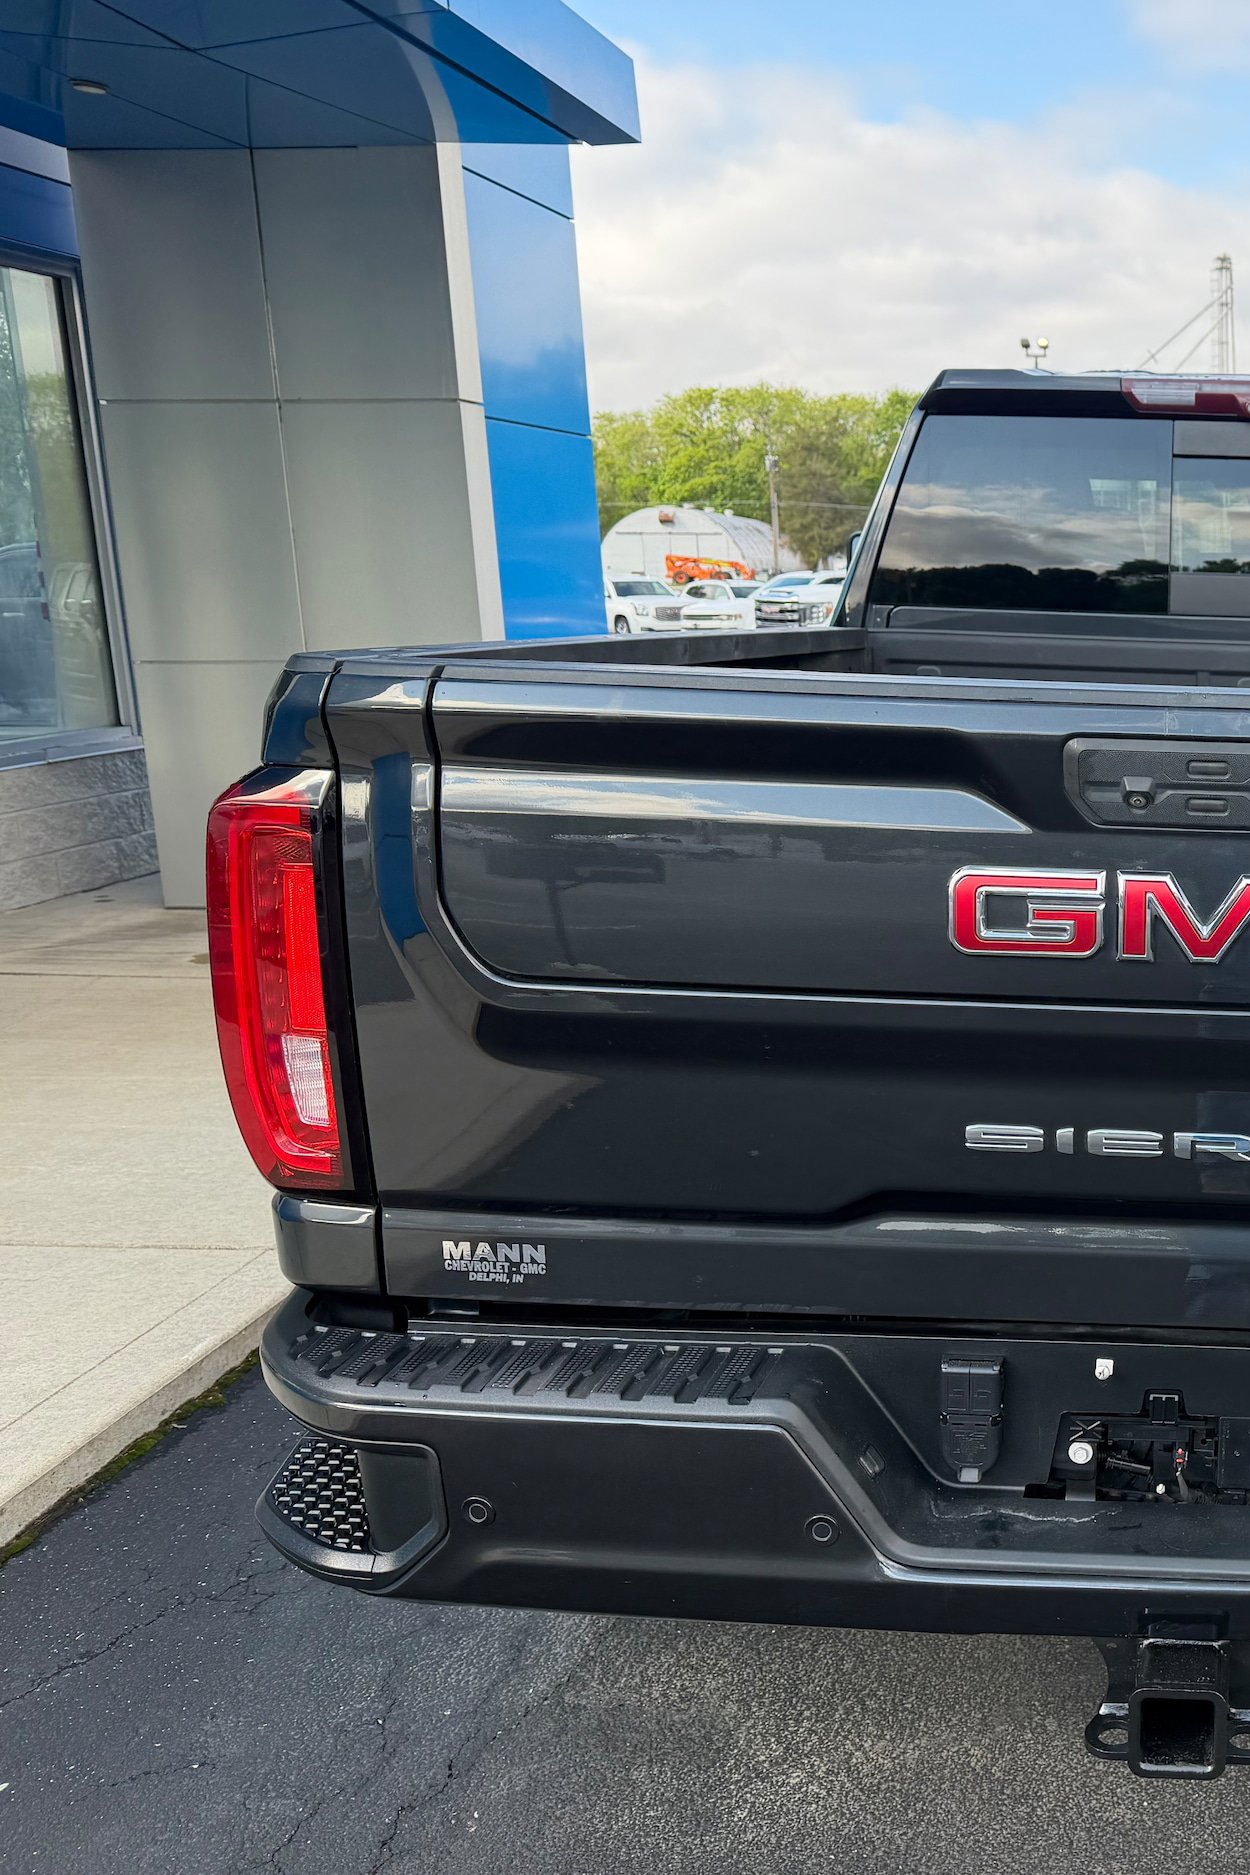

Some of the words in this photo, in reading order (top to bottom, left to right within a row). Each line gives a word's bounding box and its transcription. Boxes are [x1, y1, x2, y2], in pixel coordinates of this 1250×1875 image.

[442, 1240, 547, 1264] MANN
[444, 1259, 510, 1273] CHEVROLET
[519, 1262, 547, 1275] GMC
[468, 1271, 510, 1285] DELPHI,
[512, 1273, 524, 1283] IN
